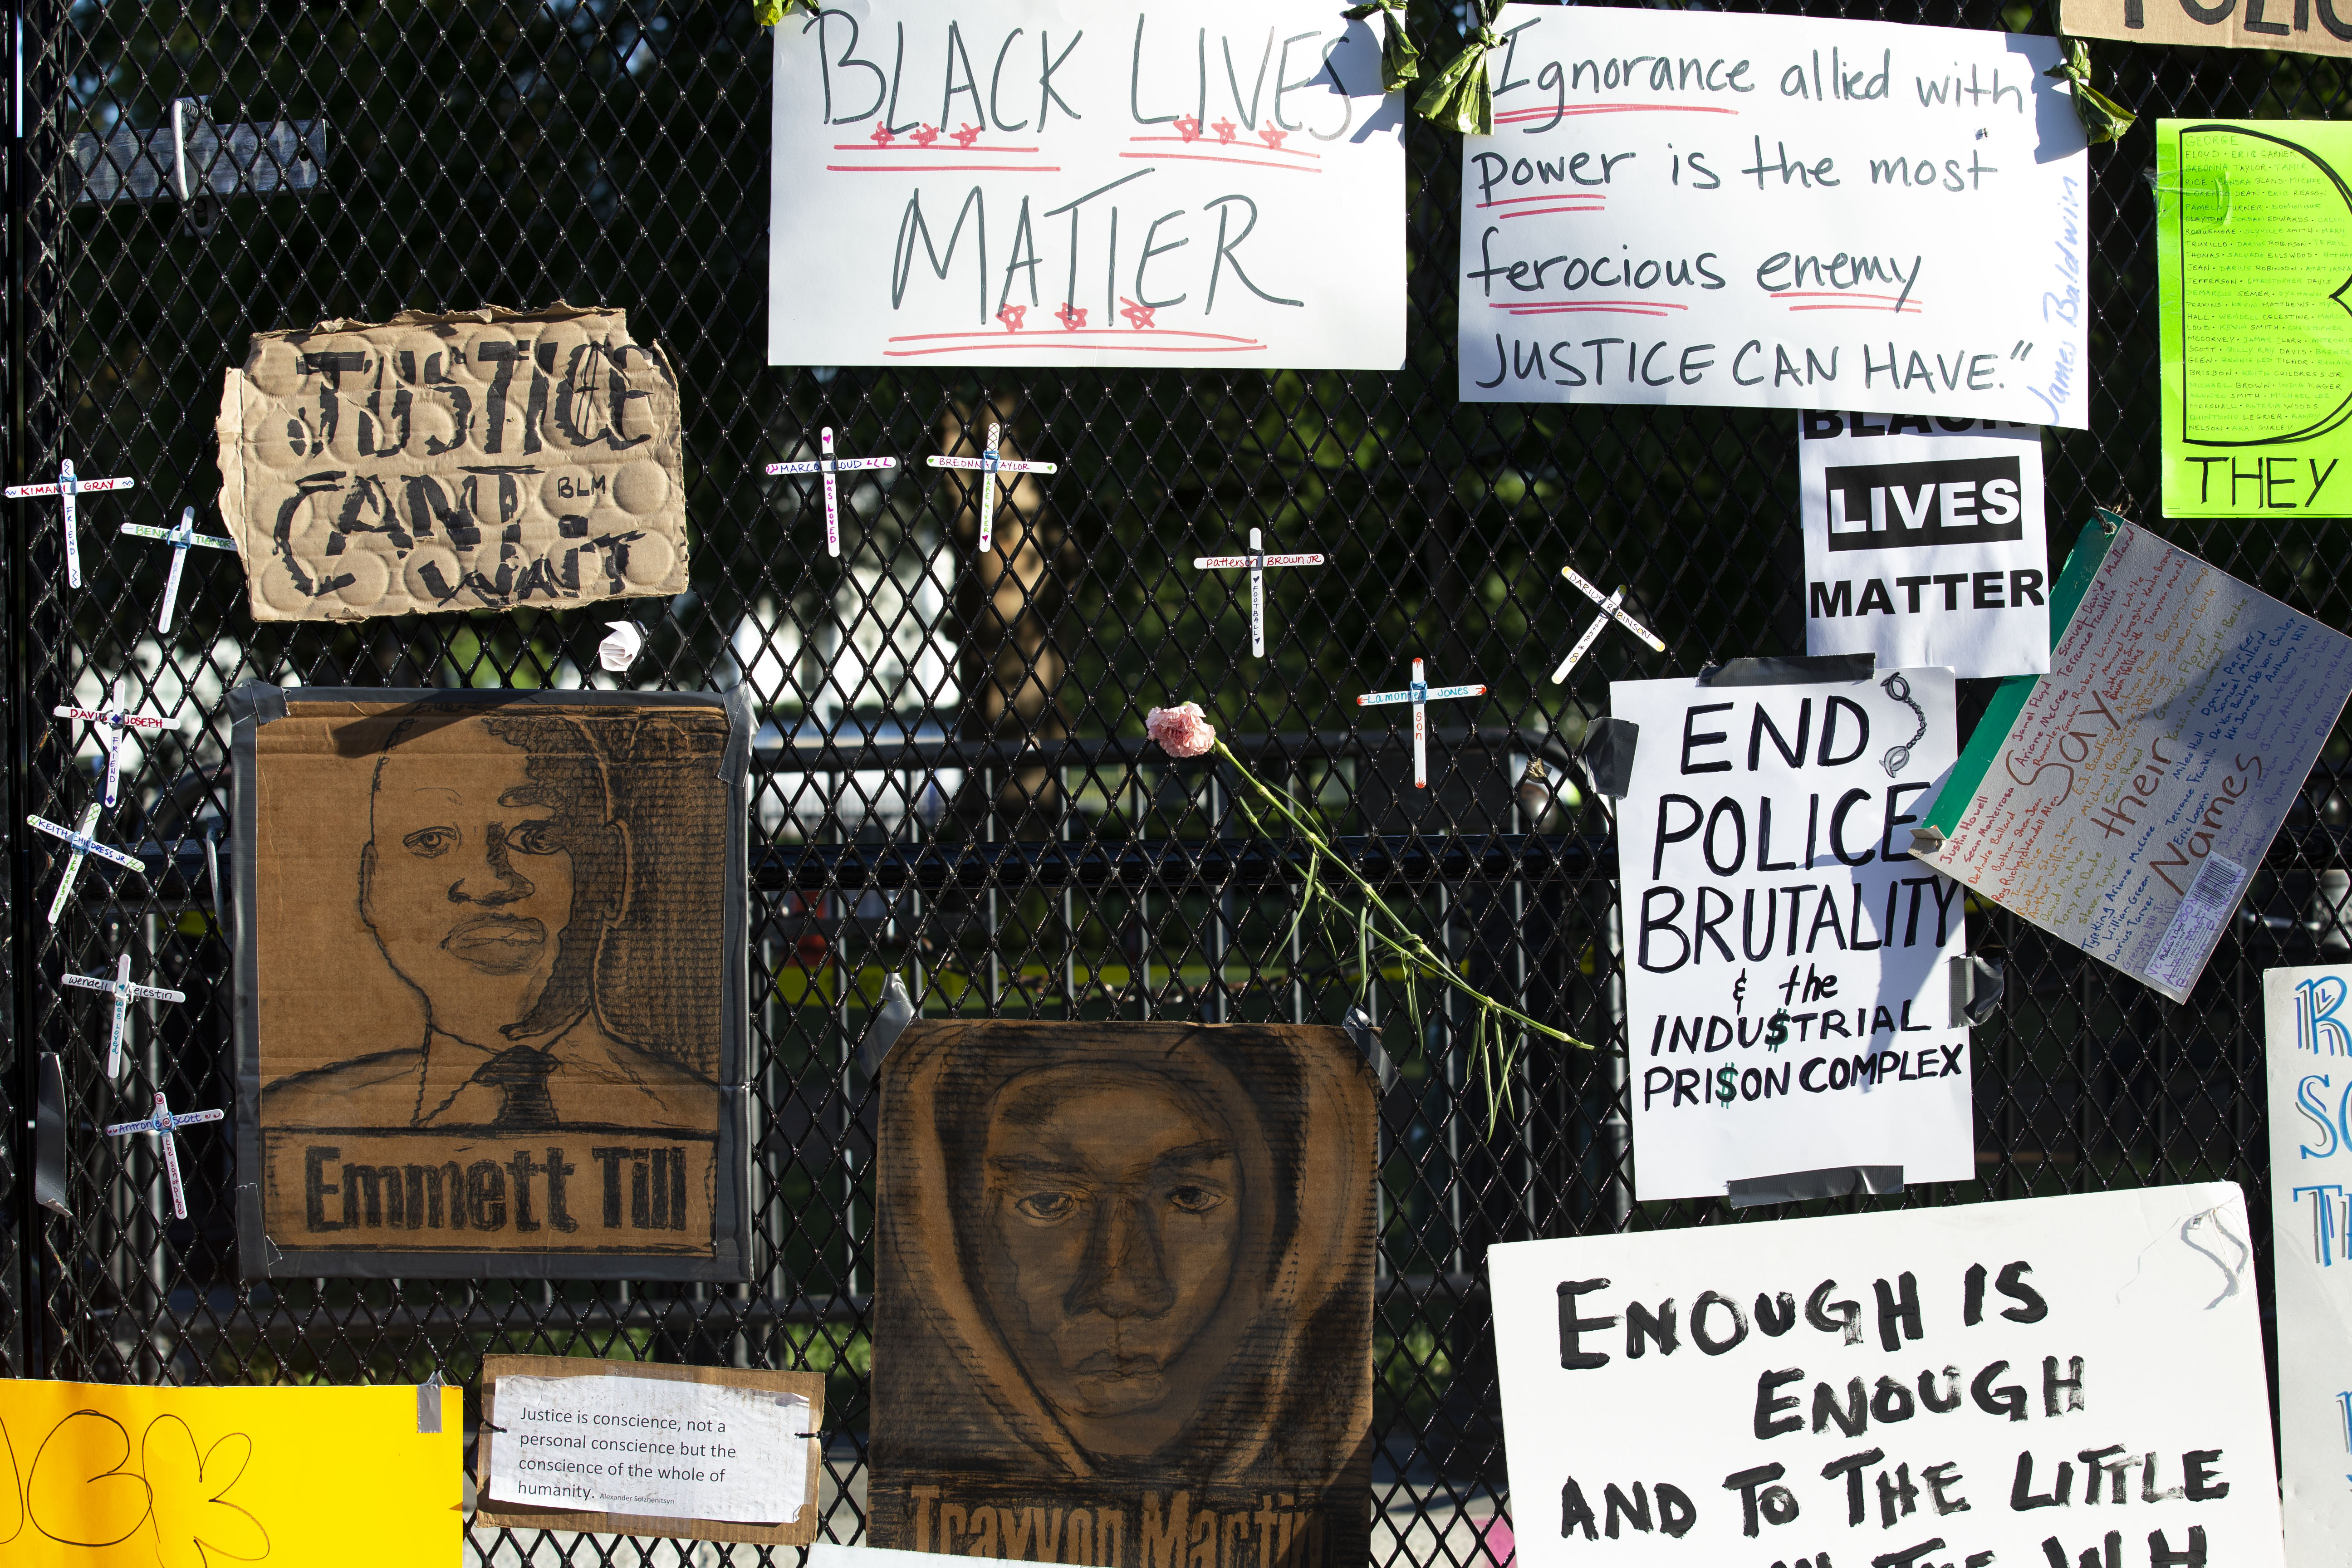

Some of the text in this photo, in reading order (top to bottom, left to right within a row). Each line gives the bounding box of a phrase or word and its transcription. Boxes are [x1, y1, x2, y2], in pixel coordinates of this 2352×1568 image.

[802, 9, 1352, 142] BLACK LIVES
[1493, 17, 2023, 133] Ignorance allied with
[2185, 135, 2239, 147] GEORGE
[2185, 163, 2308, 173] BREONNA TAYLOR TAMIR
[2186, 149, 2297, 161] FLOYD ERIC GARNER
[1471, 134, 1999, 207] power is the most
[1467, 226, 1922, 313] ferocious enemy
[2026, 175, 2079, 429] James Baldwin
[1475, 333, 1716, 389] JUSTICE
[1732, 340, 1839, 389] CAN
[84, 480, 114, 490] GRAY
[557, 475, 606, 499] BLM
[781, 463, 820, 473] MARCO
[939, 458, 990, 468] BREONNA
[2184, 456, 2339, 510] THEY
[66, 506, 76, 555] FRIEND
[1830, 478, 2020, 534] LIVES
[1569, 573, 1651, 639] DARIUS ROBINSON
[1810, 568, 2045, 618] MATTER
[2200, 631, 2254, 716] Donte Parker
[2265, 625, 2308, 683] Anthony Hill
[125, 716, 162, 728] JOSEPH
[1681, 695, 1871, 775] END
[2005, 689, 2120, 806] Say
[109, 737, 119, 783] FRIEND
[2172, 731, 2205, 780] Miles Hall
[2090, 737, 2172, 839] their
[38, 819, 68, 838] KEITH
[1652, 781, 1932, 880] POLICE
[1939, 796, 1988, 864] Justin Howell
[1964, 787, 2014, 862] Sean Monterrosa
[2149, 752, 2263, 897] Names
[2173, 793, 2210, 845] Eric Logan
[1637, 874, 1961, 974] BRUTALITY
[2102, 876, 2150, 940] William Green
[2106, 895, 2154, 962] Darius Tarver
[1779, 962, 1838, 1007] the
[1798, 1043, 1964, 1093] COMPLEX
[304, 1145, 688, 1233] Emmett Till
[1556, 1260, 2048, 1370] ENOUGH IS
[521, 1407, 726, 1433] Justice is conscience, not a
[1753, 1355, 2085, 1440] ENOUGH
[519, 1458, 726, 1483] conscience of the whole of
[520, 1432, 736, 1458] personal conscience but the
[518, 1481, 675, 1505] humanity. Alexander Solzhenitsyn
[1559, 1475, 1697, 1542] AND
[1820, 1447, 1971, 1530] THE
[2010, 1445, 2231, 1513] LITTLE
